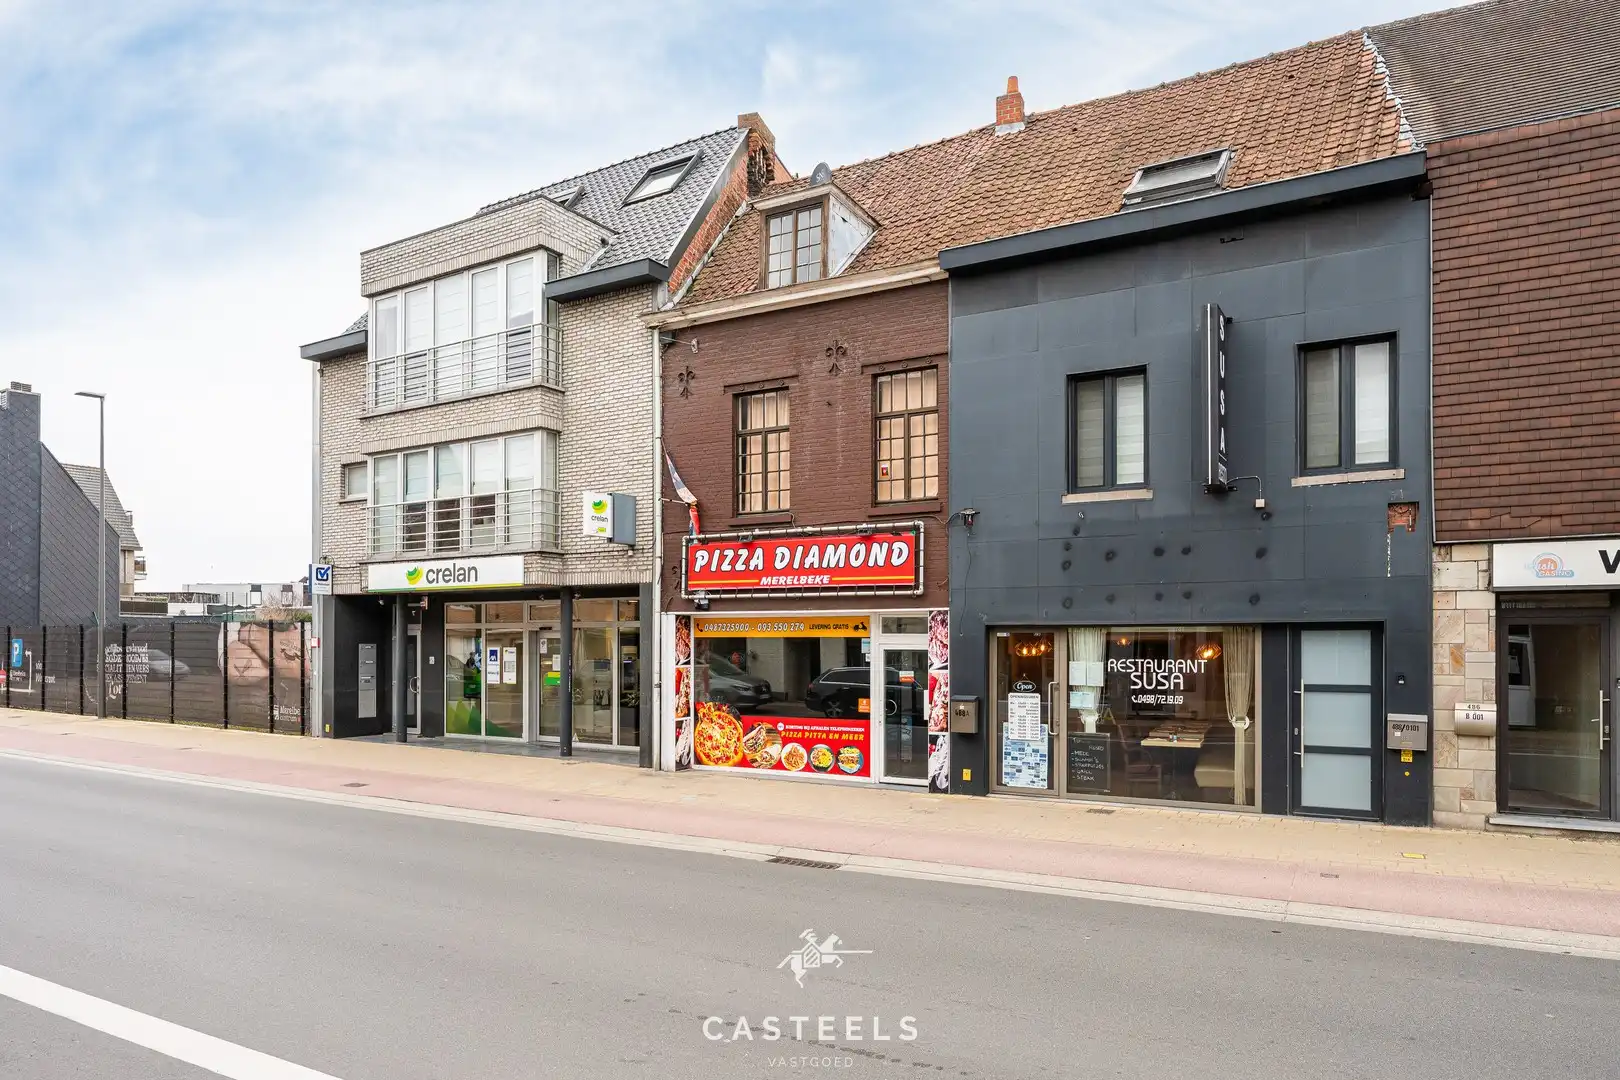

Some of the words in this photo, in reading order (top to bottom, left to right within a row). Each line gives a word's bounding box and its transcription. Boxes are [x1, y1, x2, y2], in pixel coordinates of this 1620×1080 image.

[694, 547, 764, 572] PIZZA
[773, 541, 909, 571] DIAMOND
[426, 563, 478, 584] crelan
[760, 575, 830, 585] MERELBEKE
[757, 622, 771, 632] 093
[773, 622, 788, 632] 550
[1107, 658, 1207, 673] RESTAURANT
[1016, 682, 1033, 691] Open
[1130, 672, 1184, 690] SUSA
